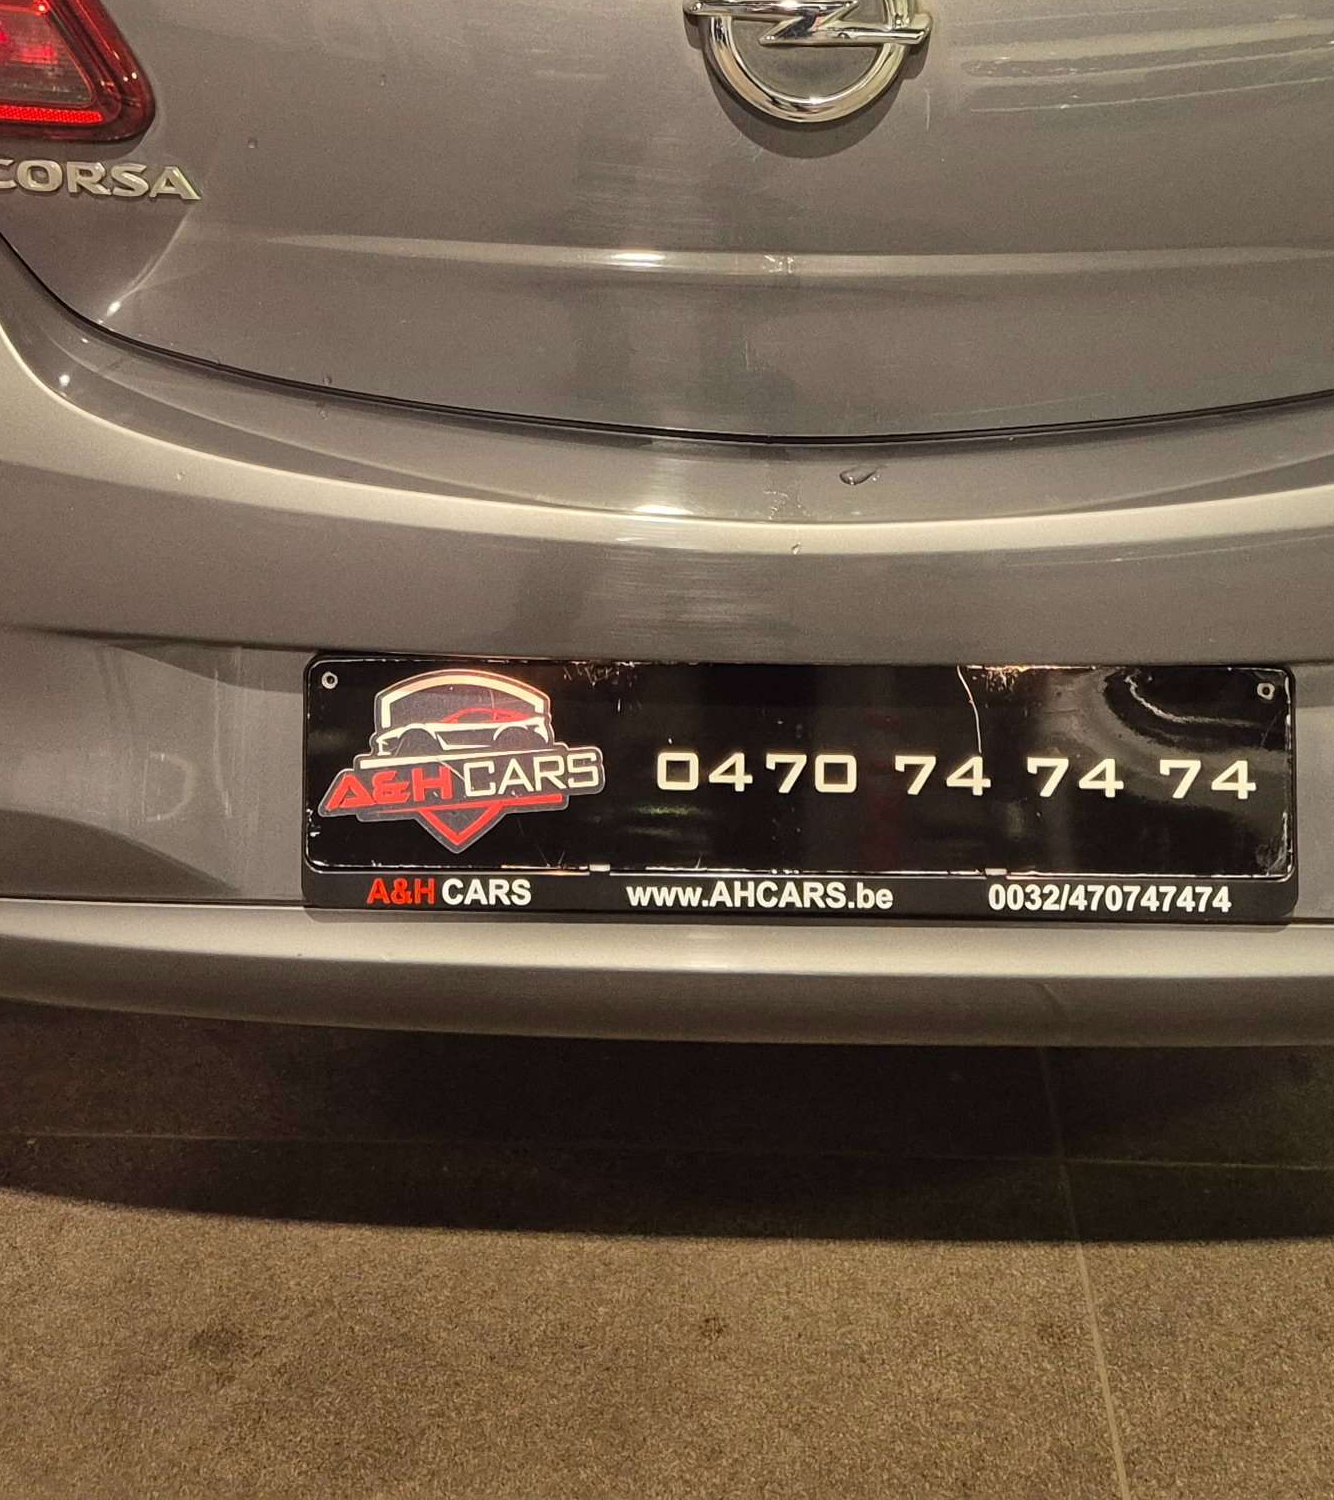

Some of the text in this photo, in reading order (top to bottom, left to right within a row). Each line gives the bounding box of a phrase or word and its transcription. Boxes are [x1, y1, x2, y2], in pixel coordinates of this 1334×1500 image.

[327, 752, 600, 811] A&H CARS
[657, 752, 1257, 799] 0470 74 74 74
[367, 878, 532, 906] A&H CARS
[626, 881, 894, 909] www.AHCARS.be
[988, 883, 1232, 912] 0032/470747474
